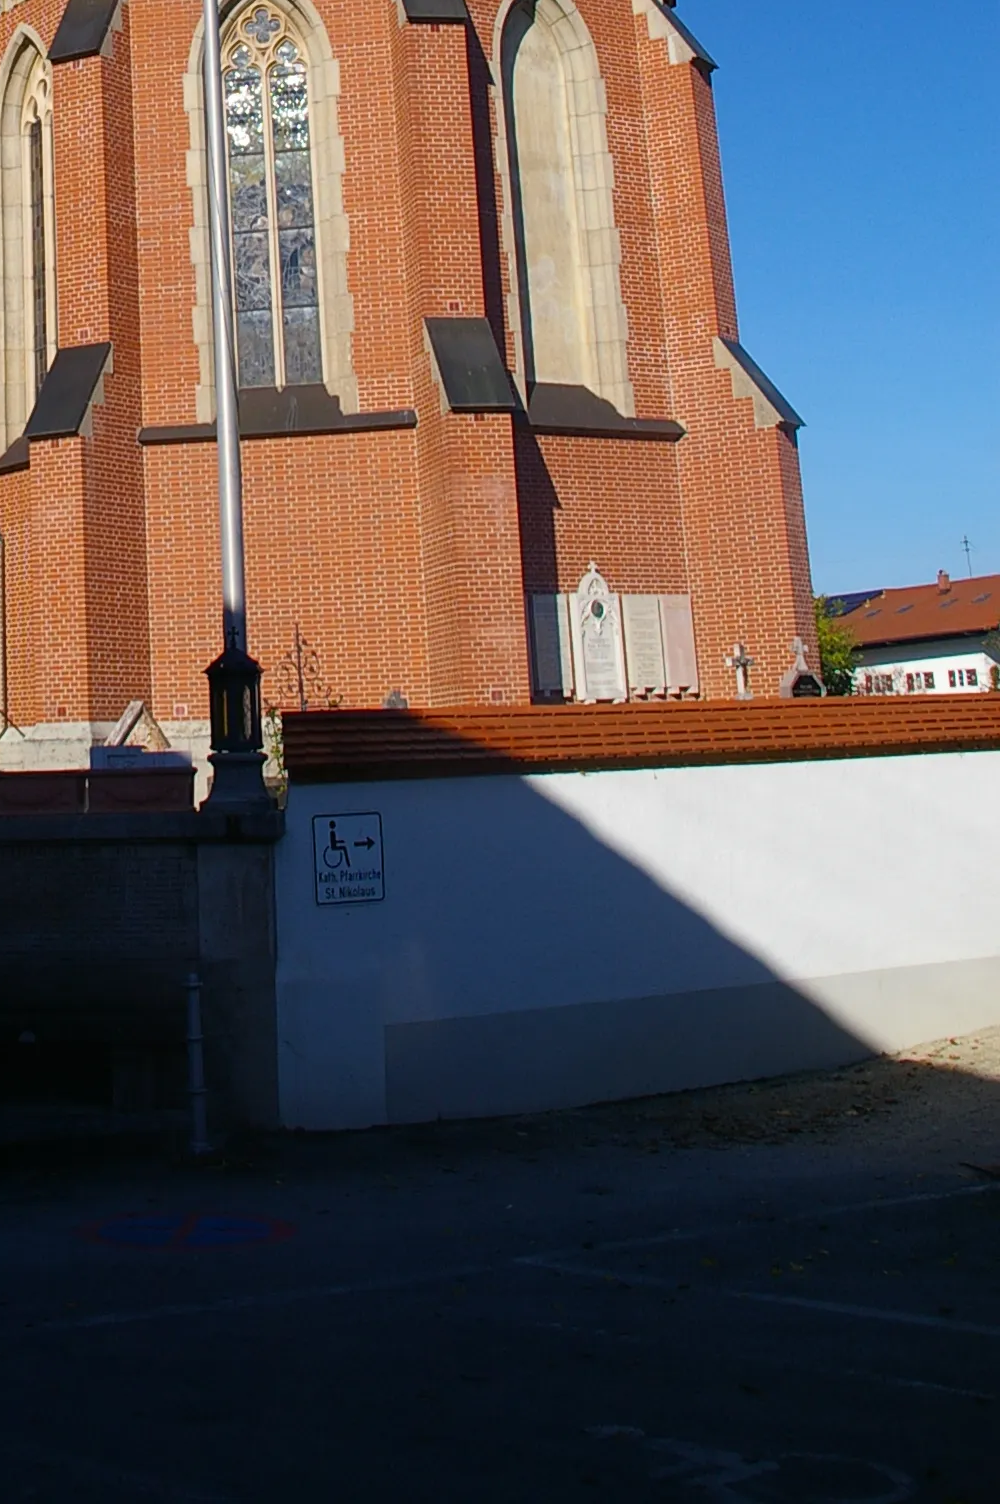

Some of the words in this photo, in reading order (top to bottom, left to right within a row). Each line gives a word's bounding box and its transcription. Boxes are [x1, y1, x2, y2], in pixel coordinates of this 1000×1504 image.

[319, 871, 338, 883] Kath.
[340, 868, 381, 882] Pfarrkirche
[325, 887, 337, 900] St.
[339, 885, 376, 898] Nikolaus
